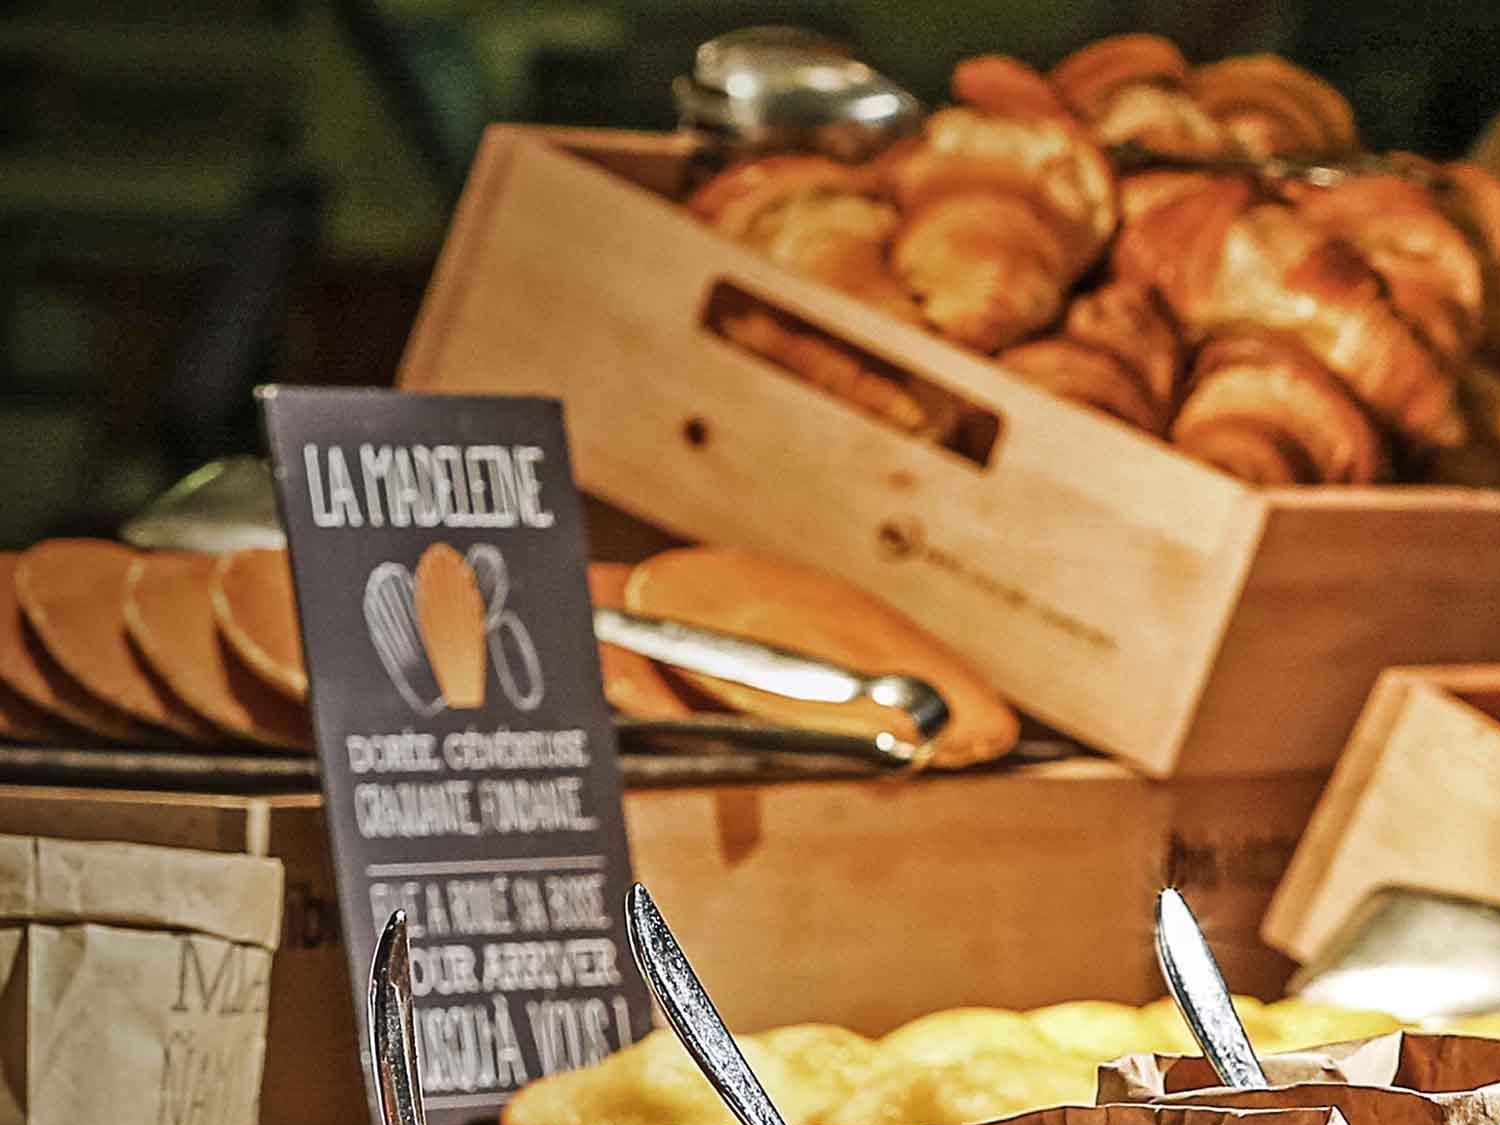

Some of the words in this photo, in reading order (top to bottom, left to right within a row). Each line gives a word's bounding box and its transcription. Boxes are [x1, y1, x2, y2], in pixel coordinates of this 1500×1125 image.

[304, 443, 363, 528] LA
[359, 442, 555, 529] MADELEINE
[410, 943, 481, 997] OUR
